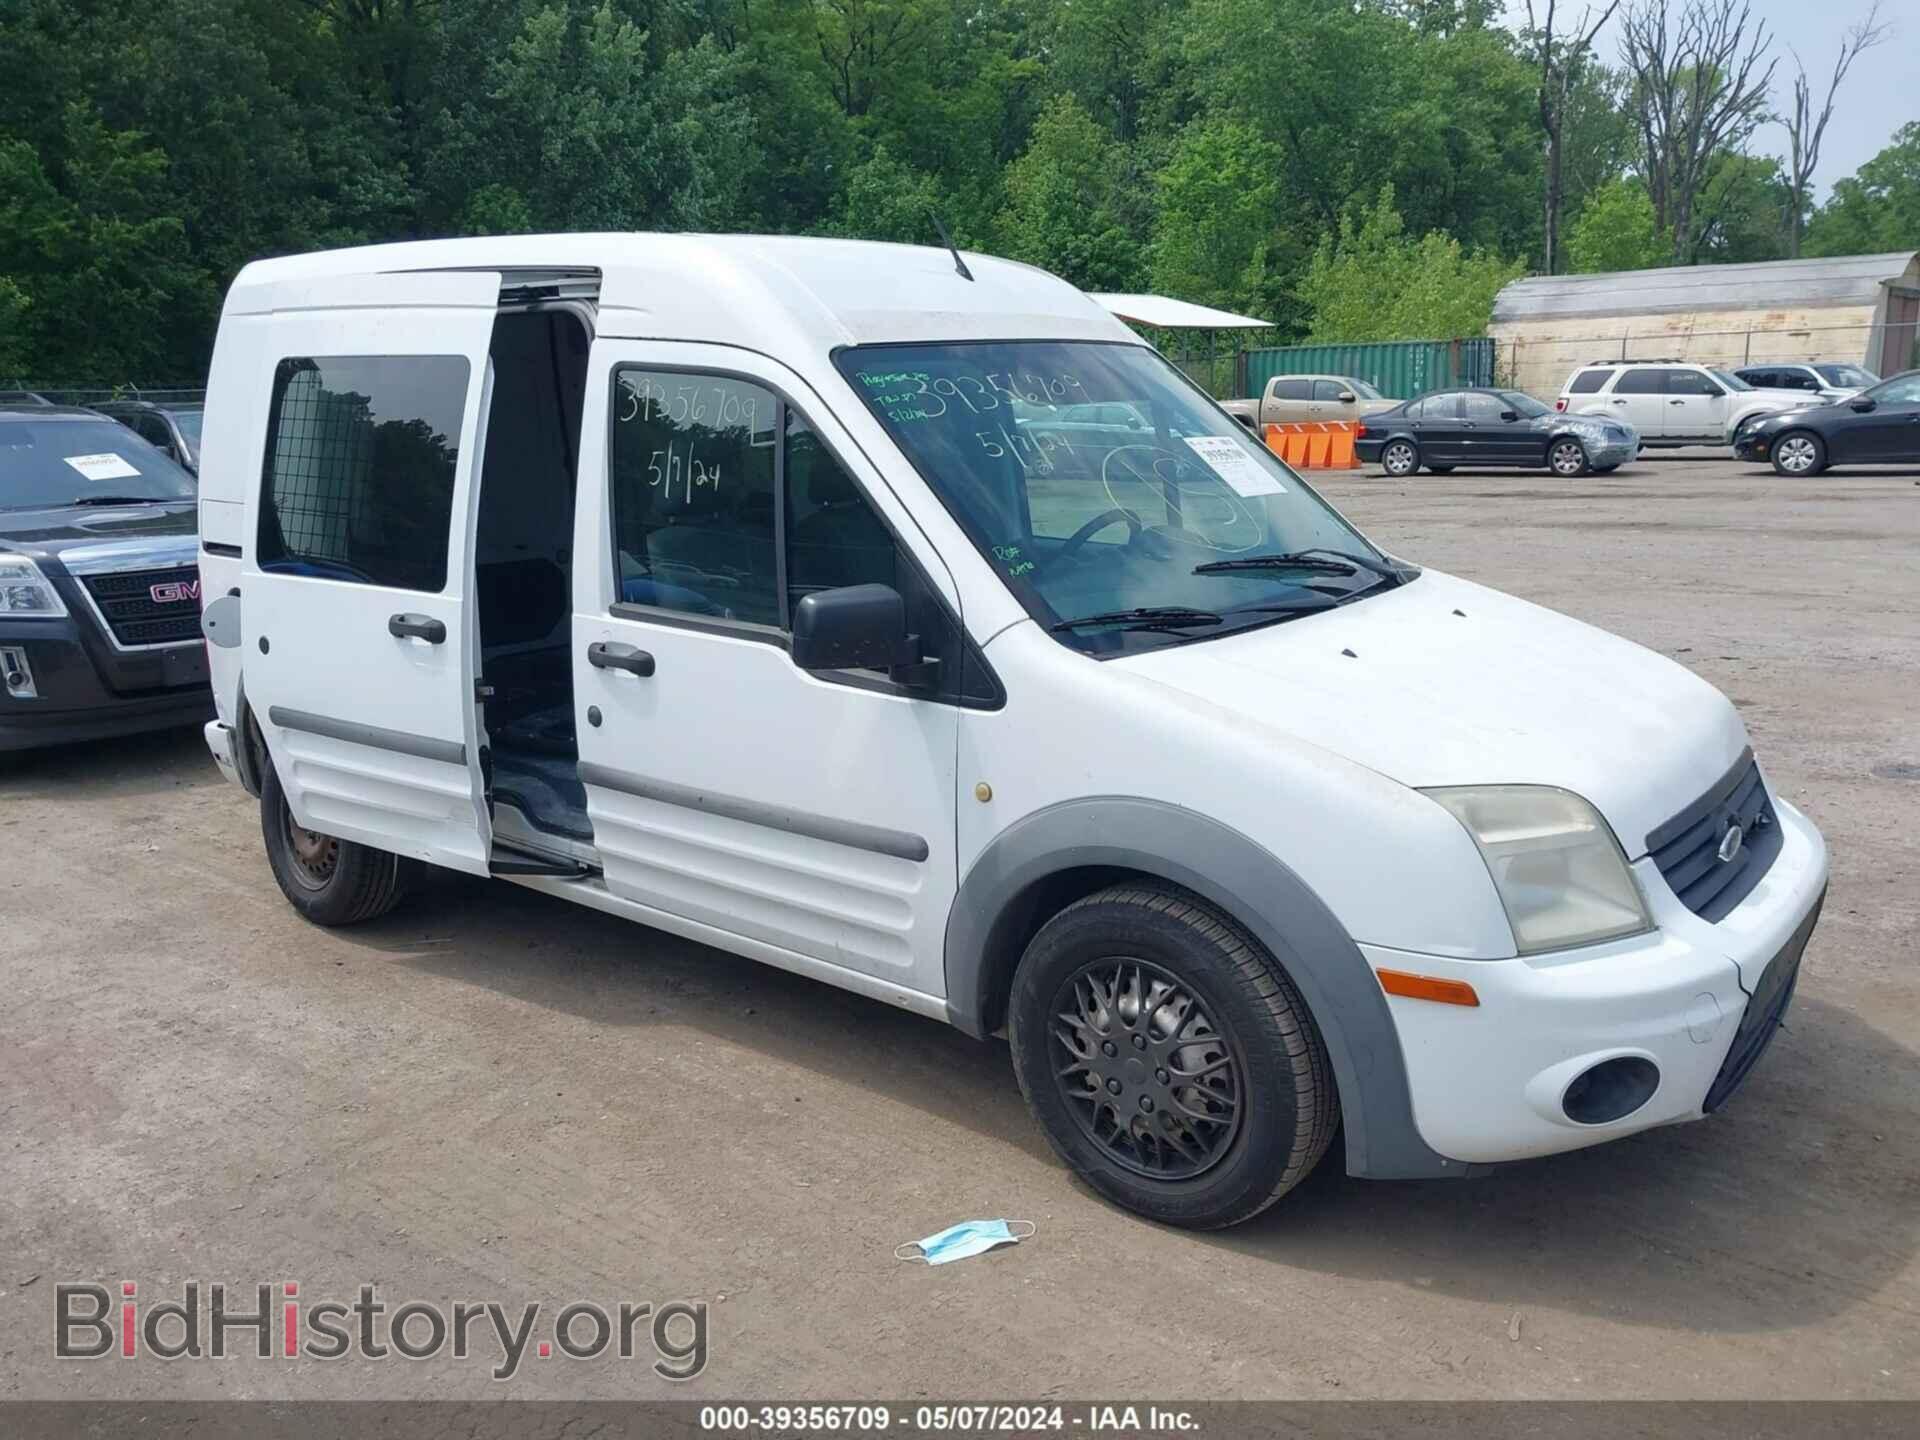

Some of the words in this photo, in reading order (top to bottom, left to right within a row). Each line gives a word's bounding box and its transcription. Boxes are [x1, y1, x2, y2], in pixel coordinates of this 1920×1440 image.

[619, 378, 757, 438] 39356709
[904, 372, 1094, 418] 39356709
[647, 440, 721, 504] 5/7/24
